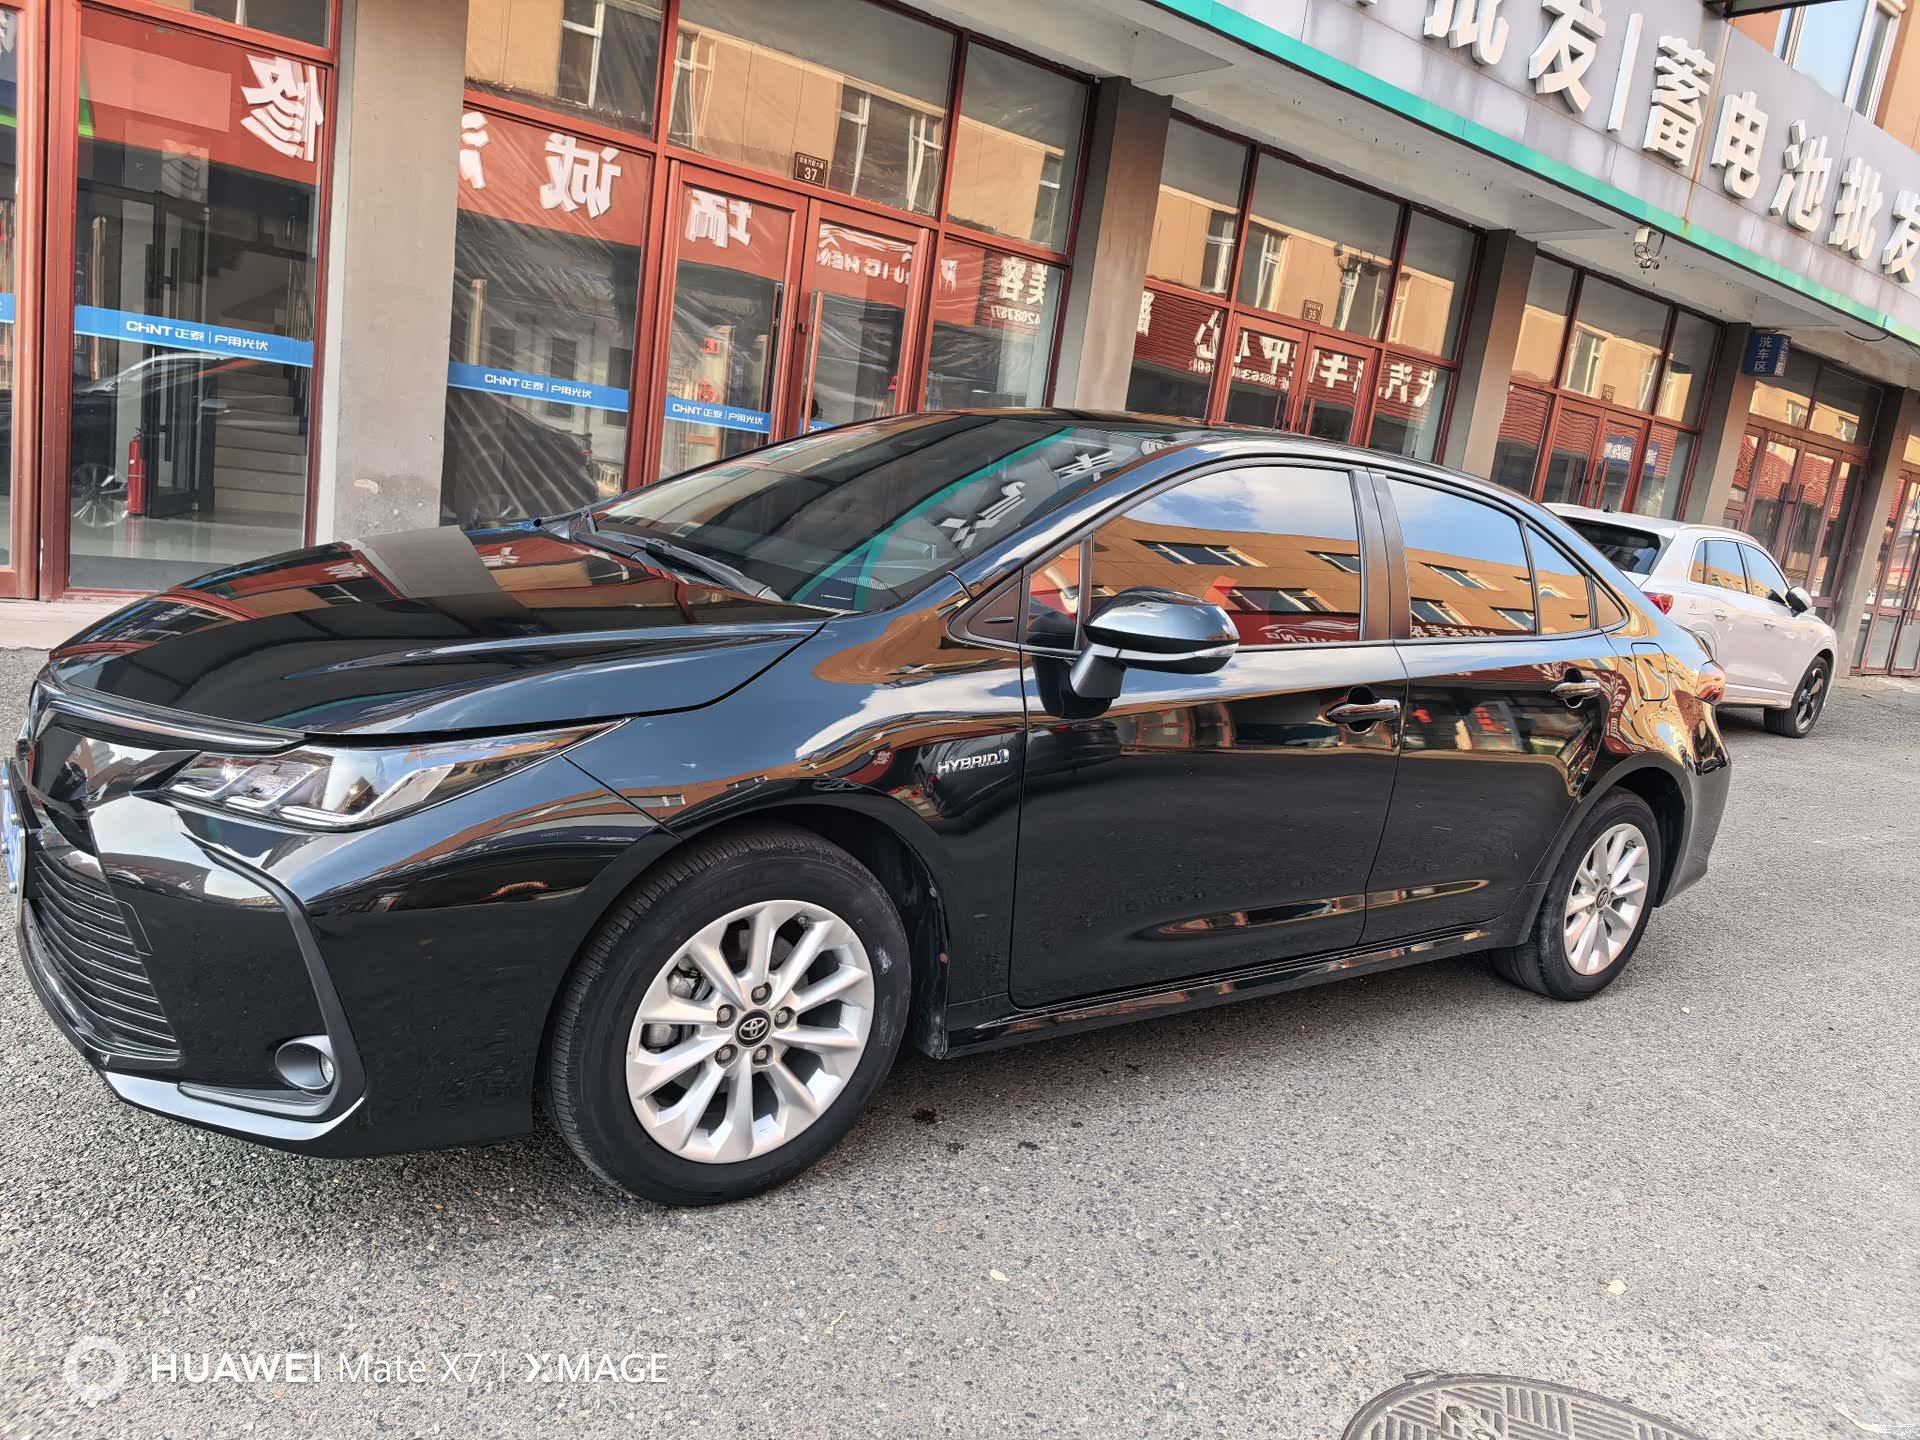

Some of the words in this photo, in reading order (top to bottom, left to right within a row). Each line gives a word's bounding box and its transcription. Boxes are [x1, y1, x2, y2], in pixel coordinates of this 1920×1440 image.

[1642, 35, 1920, 284] 蓄电池批发
[804, 167, 818, 181] 37
[175, 327, 205, 342] 正泰
[214, 334, 269, 351] 户用光伏
[1754, 336, 1773, 373] 洗车区
[521, 379, 545, 392] 正泰
[551, 384, 593, 399] 户用光伏
[703, 408, 723, 419] 正泰
[728, 412, 764, 426] 户用光伏
[937, 753, 999, 773] HYBRID
